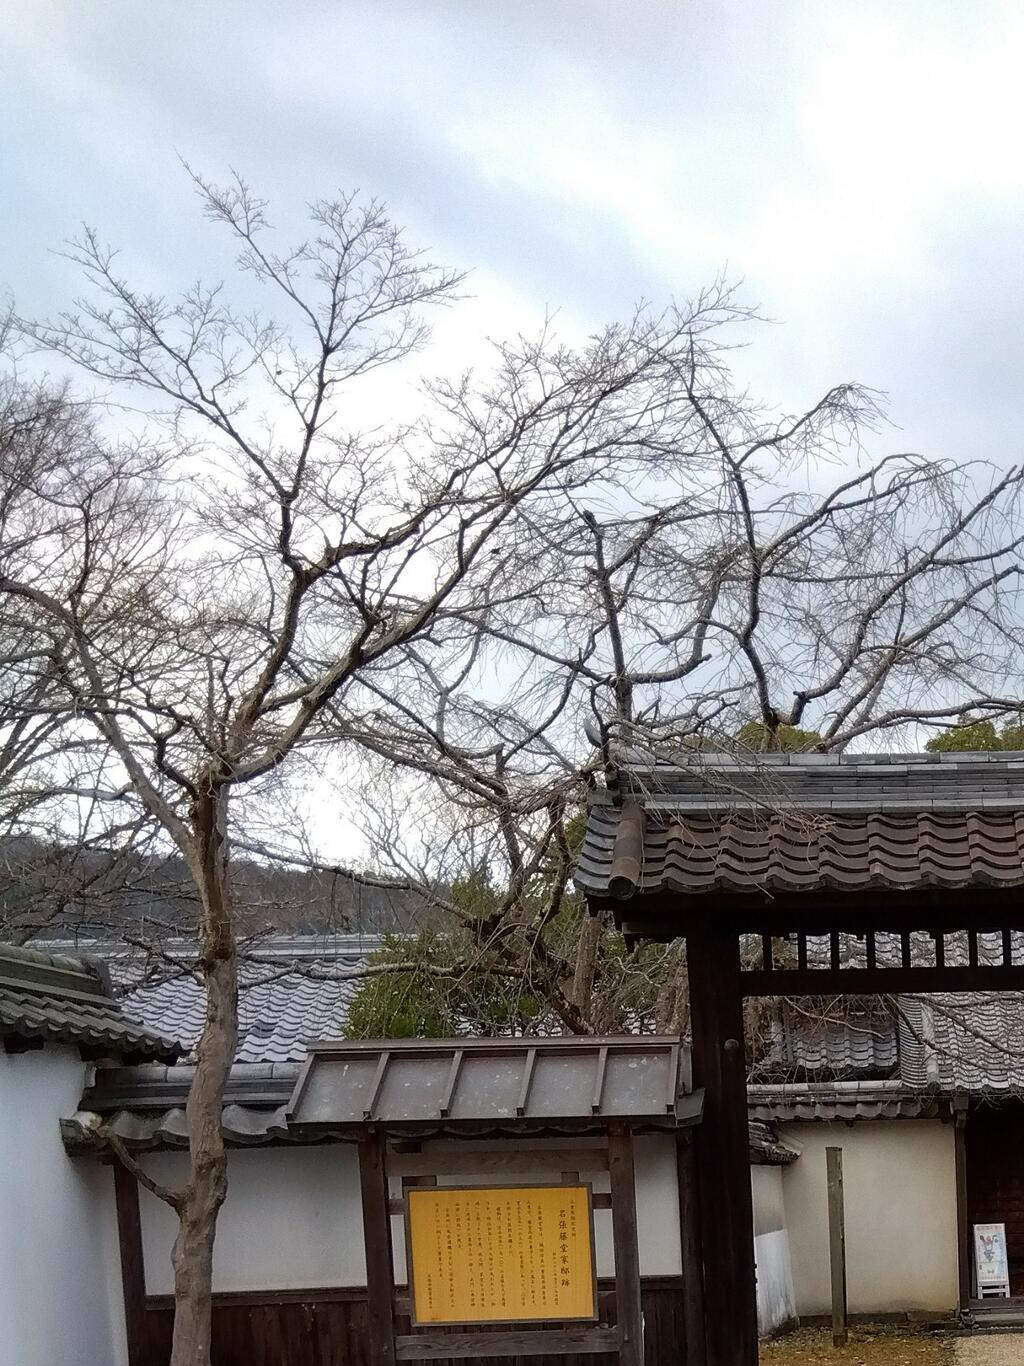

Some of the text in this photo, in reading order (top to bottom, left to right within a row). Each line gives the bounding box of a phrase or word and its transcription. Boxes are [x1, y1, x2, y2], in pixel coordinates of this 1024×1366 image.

[558, 1209, 570, 1288] 名張藤堂家邸跡
